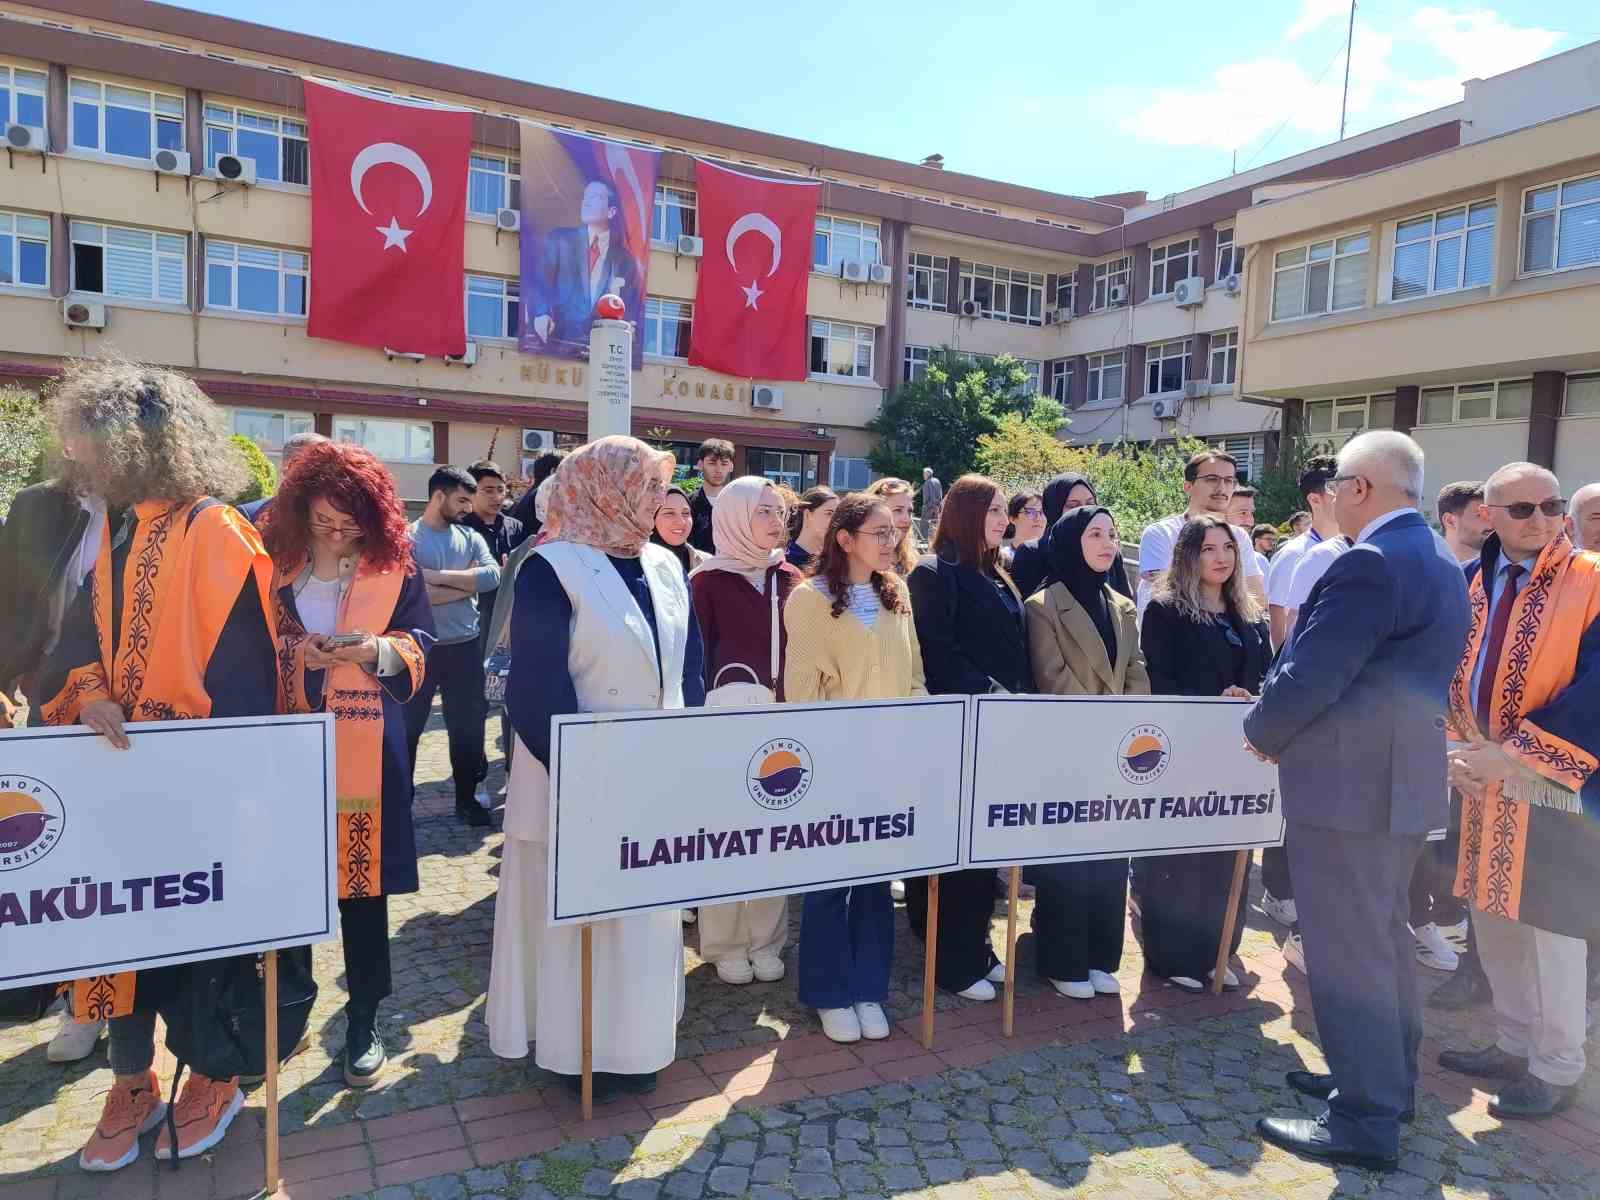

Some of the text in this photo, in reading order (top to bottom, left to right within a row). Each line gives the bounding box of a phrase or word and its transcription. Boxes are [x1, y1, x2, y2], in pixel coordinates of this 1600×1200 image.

[1, 780, 42, 794] NOP
[987, 789, 1276, 827] FEN EDEBİYAT FAKÜLTESİ
[620, 807, 915, 870] İLAHİYAT FAKÜLTESİ
[0, 862, 224, 928] AKÜLTESİ
